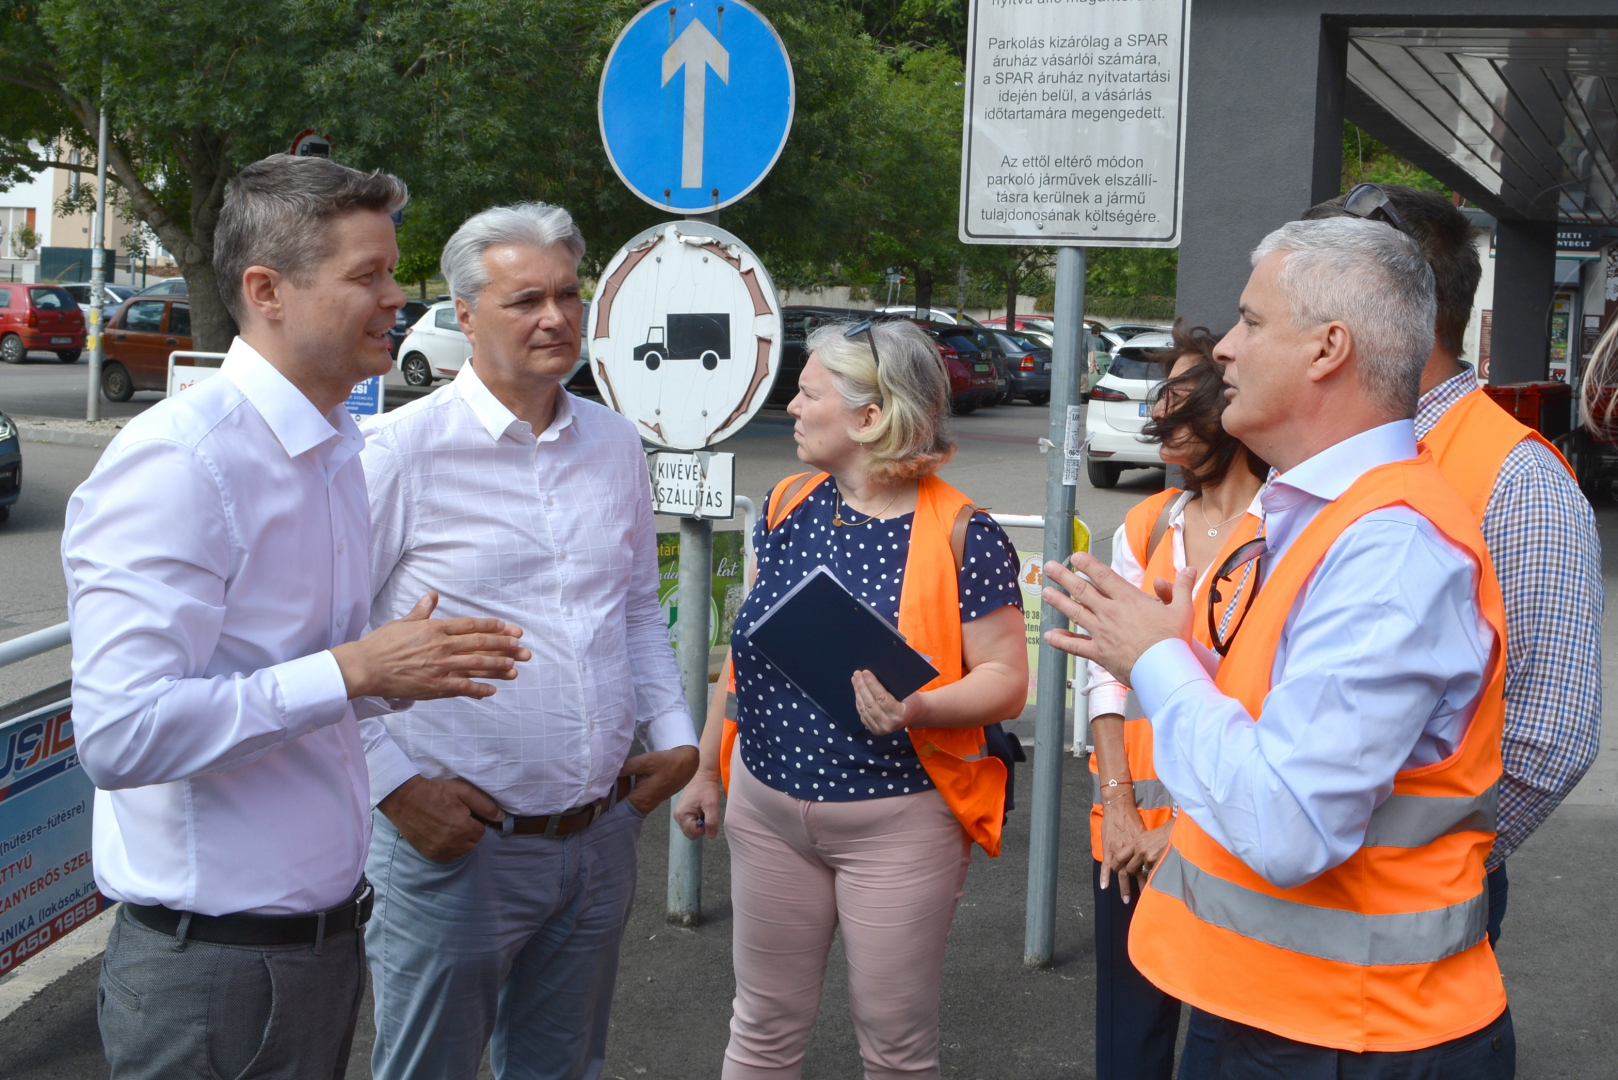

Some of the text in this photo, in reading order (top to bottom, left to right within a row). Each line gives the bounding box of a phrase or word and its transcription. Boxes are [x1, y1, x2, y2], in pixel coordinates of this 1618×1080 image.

[989, 34, 1167, 50] Parkolás kizárólag a SPAR
[993, 52, 1160, 67] áruház vásárlói számára,
[983, 70, 1170, 86] a SPAR áruház nyitvatartási
[999, 88, 1151, 103] idején belül, a vásárlás
[985, 106, 1164, 121] időtartamára megengedett.
[1001, 155, 1143, 168] Az ettől eltérő módon
[987, 173, 1157, 188] parkoló járművek elszállí-
[997, 191, 1145, 207] tásra kerülnek a jármű
[981, 208, 1159, 225] tulajdonosának költségére.
[658, 458, 698, 481] KIVÉVE
[653, 483, 723, 508] SZÁLLÍTÁS
[657, 543, 680, 557] tart
[716, 557, 739, 577] kert
[0, 799, 85, 857] (hűtésre-fűtésre)
[0, 850, 33, 885] TTYÚ
[15, 925, 51, 960] 450
[54, 896, 97, 933] 1959
